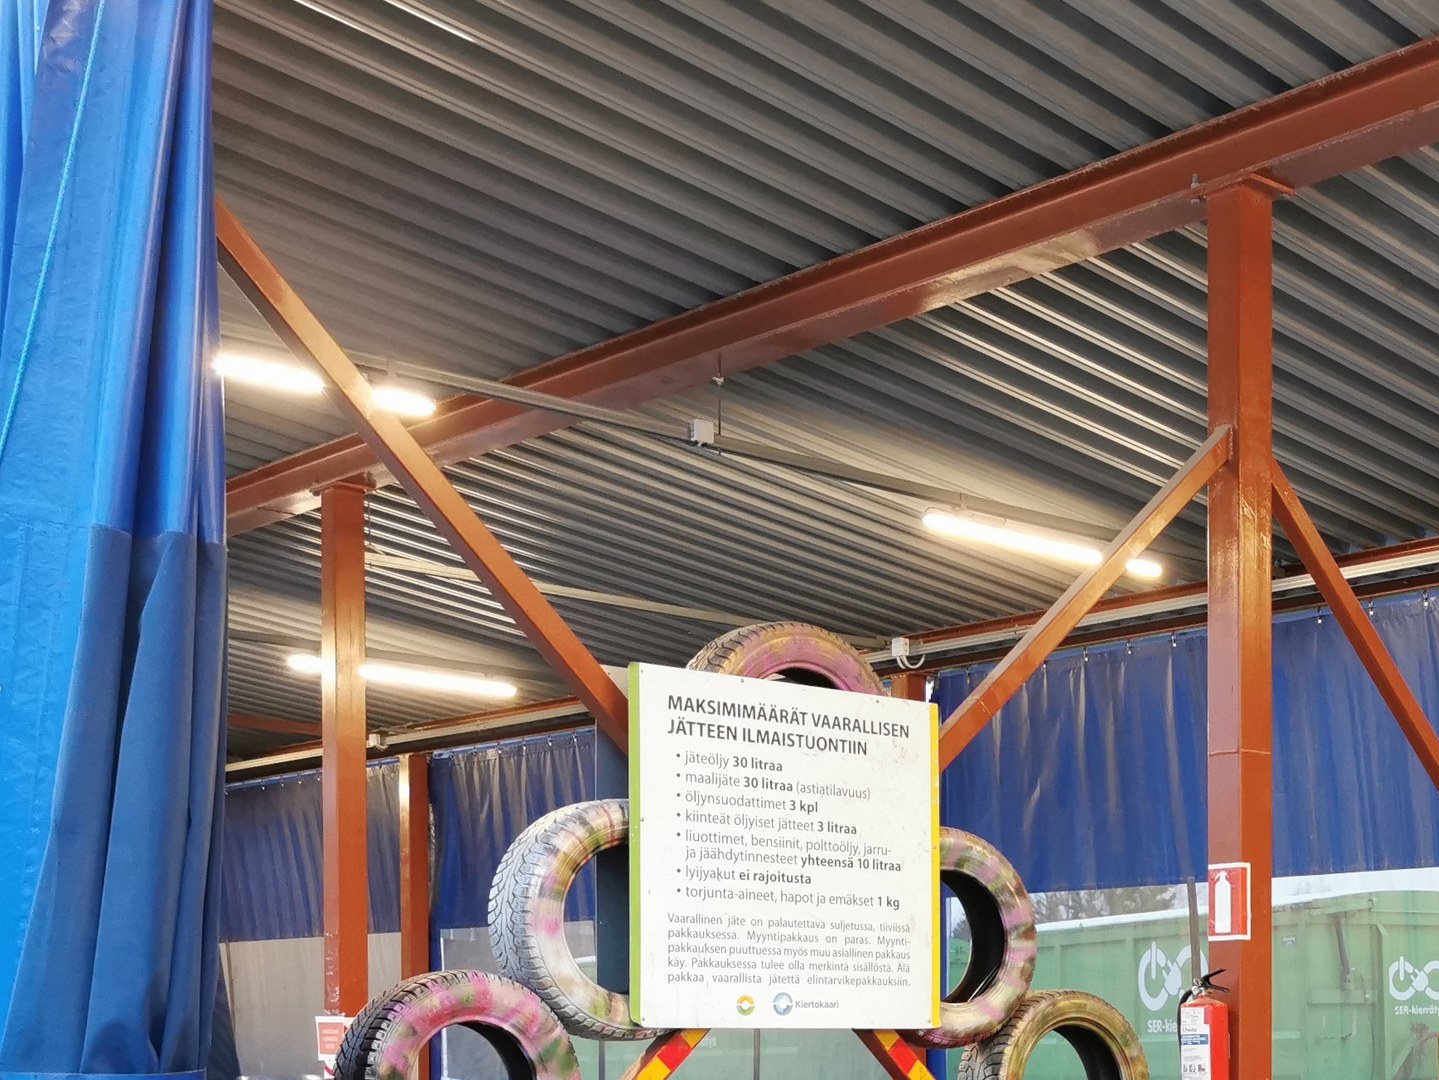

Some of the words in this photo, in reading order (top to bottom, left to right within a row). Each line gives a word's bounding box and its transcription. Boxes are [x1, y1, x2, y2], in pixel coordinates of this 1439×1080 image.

[668, 695, 808, 726] MAKSIMIMÄÄRÄT
[811, 713, 909, 738] VAARALLISEN
[667, 716, 737, 741] JÄTTEEN
[742, 727, 867, 755] ILMAISTUONTIIN
[684, 750, 729, 769] jäteöljy
[733, 756, 748, 768] 30
[751, 757, 782, 771] litraa
[685, 772, 740, 788] maalijäte
[743, 777, 758, 788] 30
[762, 777, 793, 791] litraa
[796, 780, 871, 800] (astiatilavuus)
[685, 790, 786, 810] öljynsuodattimet
[789, 800, 796, 811] 3
[800, 800, 818, 815] kpl
[685, 809, 730, 825] kiinteät
[734, 814, 775, 829] öljyiset
[778, 817, 814, 832] jätteet
[817, 821, 824, 832] 3
[828, 821, 857, 834] litraa
[685, 829, 748, 847] liuottimet,
[751, 834, 803, 851] bensiinit,
[806, 839, 861, 856] polttoöljy,
[863, 843, 892, 857] jarru-
[685, 846, 696, 861] ja
[699, 847, 798, 865] jäähdytinnesteet
[801, 854, 854, 868] yhteensä
[857, 858, 870, 869] 10
[873, 859, 901, 872] litraa
[685, 865, 736, 881] lyijyakut
[739, 869, 750, 880] ei
[754, 870, 811, 885] rajoitusta
[686, 886, 777, 903] torjunta-aineet,
[780, 890, 813, 905] hapot
[816, 893, 826, 907] ja
[829, 894, 874, 907] emäkset
[878, 896, 883, 907] 1
[886, 896, 900, 910] kg
[667, 912, 723, 925] Vaarallinen
[727, 916, 746, 928] jäte
[750, 918, 763, 926] on
[768, 917, 826, 929] palautettava
[830, 920, 875, 933] suljetussa,
[879, 923, 910, 933] tiiviissä
[667, 927, 740, 940] pakkauksessa.
[747, 930, 819, 944] Myyntipakkaus
[825, 935, 838, 943] on
[844, 936, 871, 946] paras.
[877, 936, 911, 948] Myynti-
[667, 942, 727, 955] pakkauksen
[729, 946, 781, 956] puuttuessa
[783, 947, 808, 958] myös
[810, 949, 831, 957] muu
[832, 948, 874, 959] asiallinen
[875, 949, 911, 961] pakkaus
[667, 956, 687, 970] käy.
[691, 957, 757, 969] Pakkauksessa
[761, 959, 785, 970] tulee
[788, 960, 805, 970] olla
[808, 961, 849, 972] merkintä
[852, 962, 894, 973] sisällöstä.
[667, 971, 705, 984] pakkaa
[712, 972, 762, 984] vaarallista
[768, 974, 800, 986] jätettä
[806, 974, 911, 988] elintarvikepakkauksiin.
[795, 1000, 839, 1009] Kiertokaari
[1147, 1018, 1177, 1033] SER-kie
